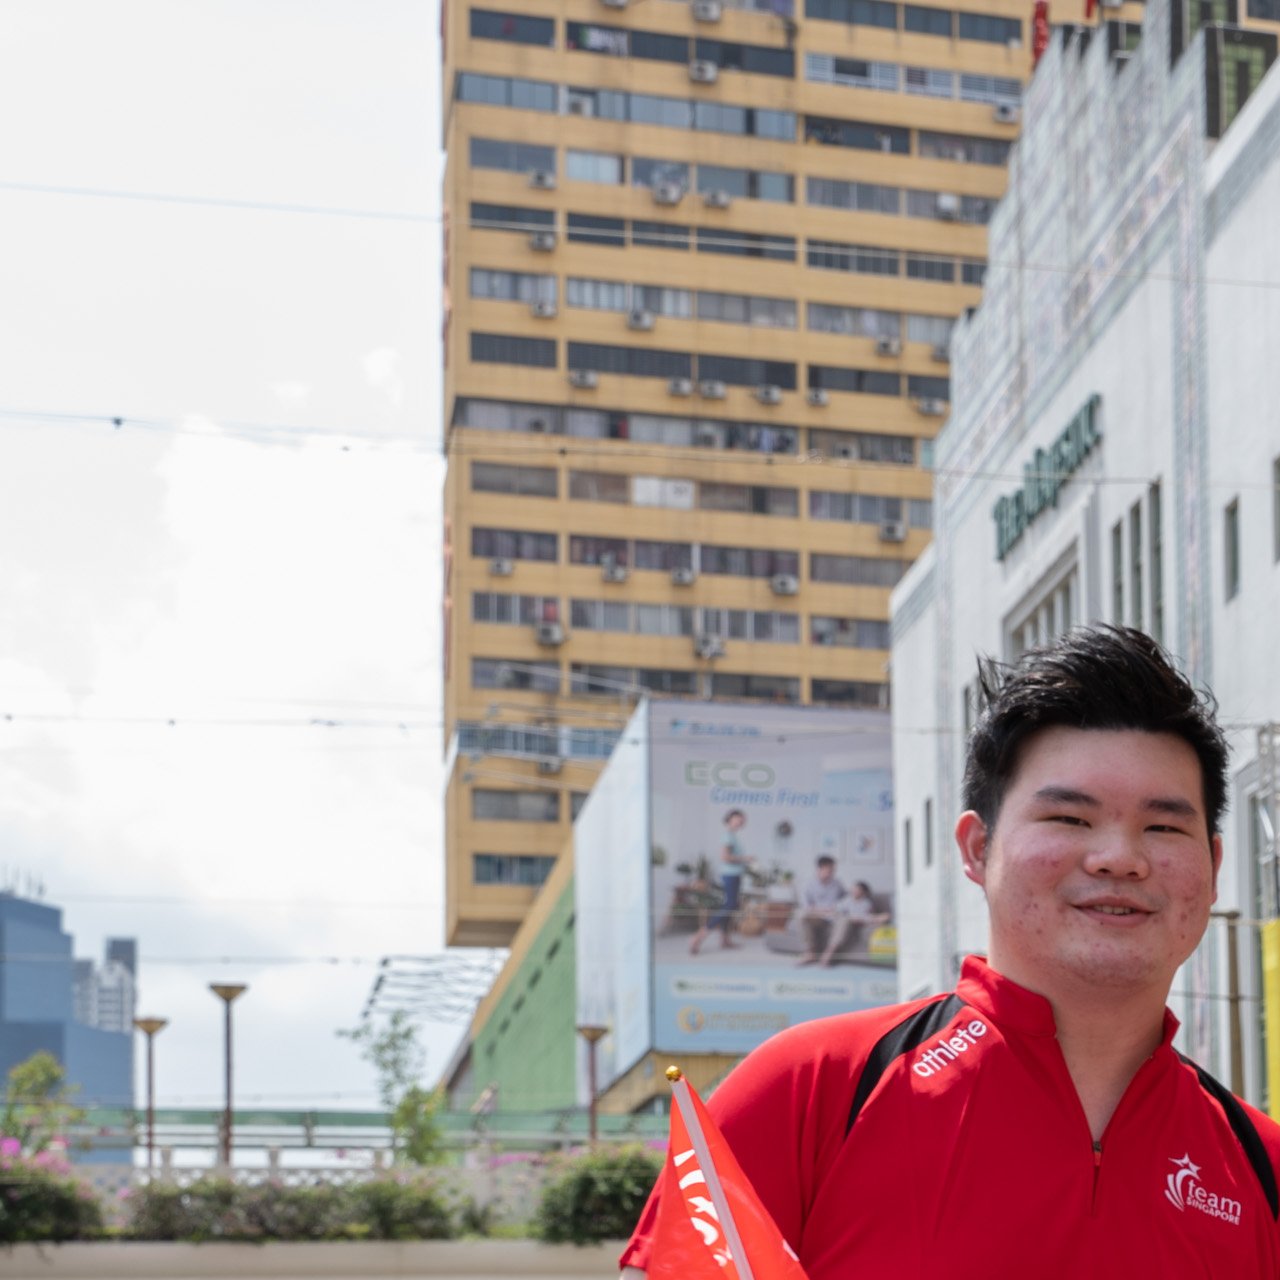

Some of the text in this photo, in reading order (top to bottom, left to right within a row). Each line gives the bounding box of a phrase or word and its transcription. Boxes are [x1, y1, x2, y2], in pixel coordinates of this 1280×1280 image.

[684, 761, 776, 788] ECO
[912, 1020, 987, 1078] athlete
[1186, 1196, 1240, 1226] SINGAPORE
[1187, 1179, 1242, 1217] team
